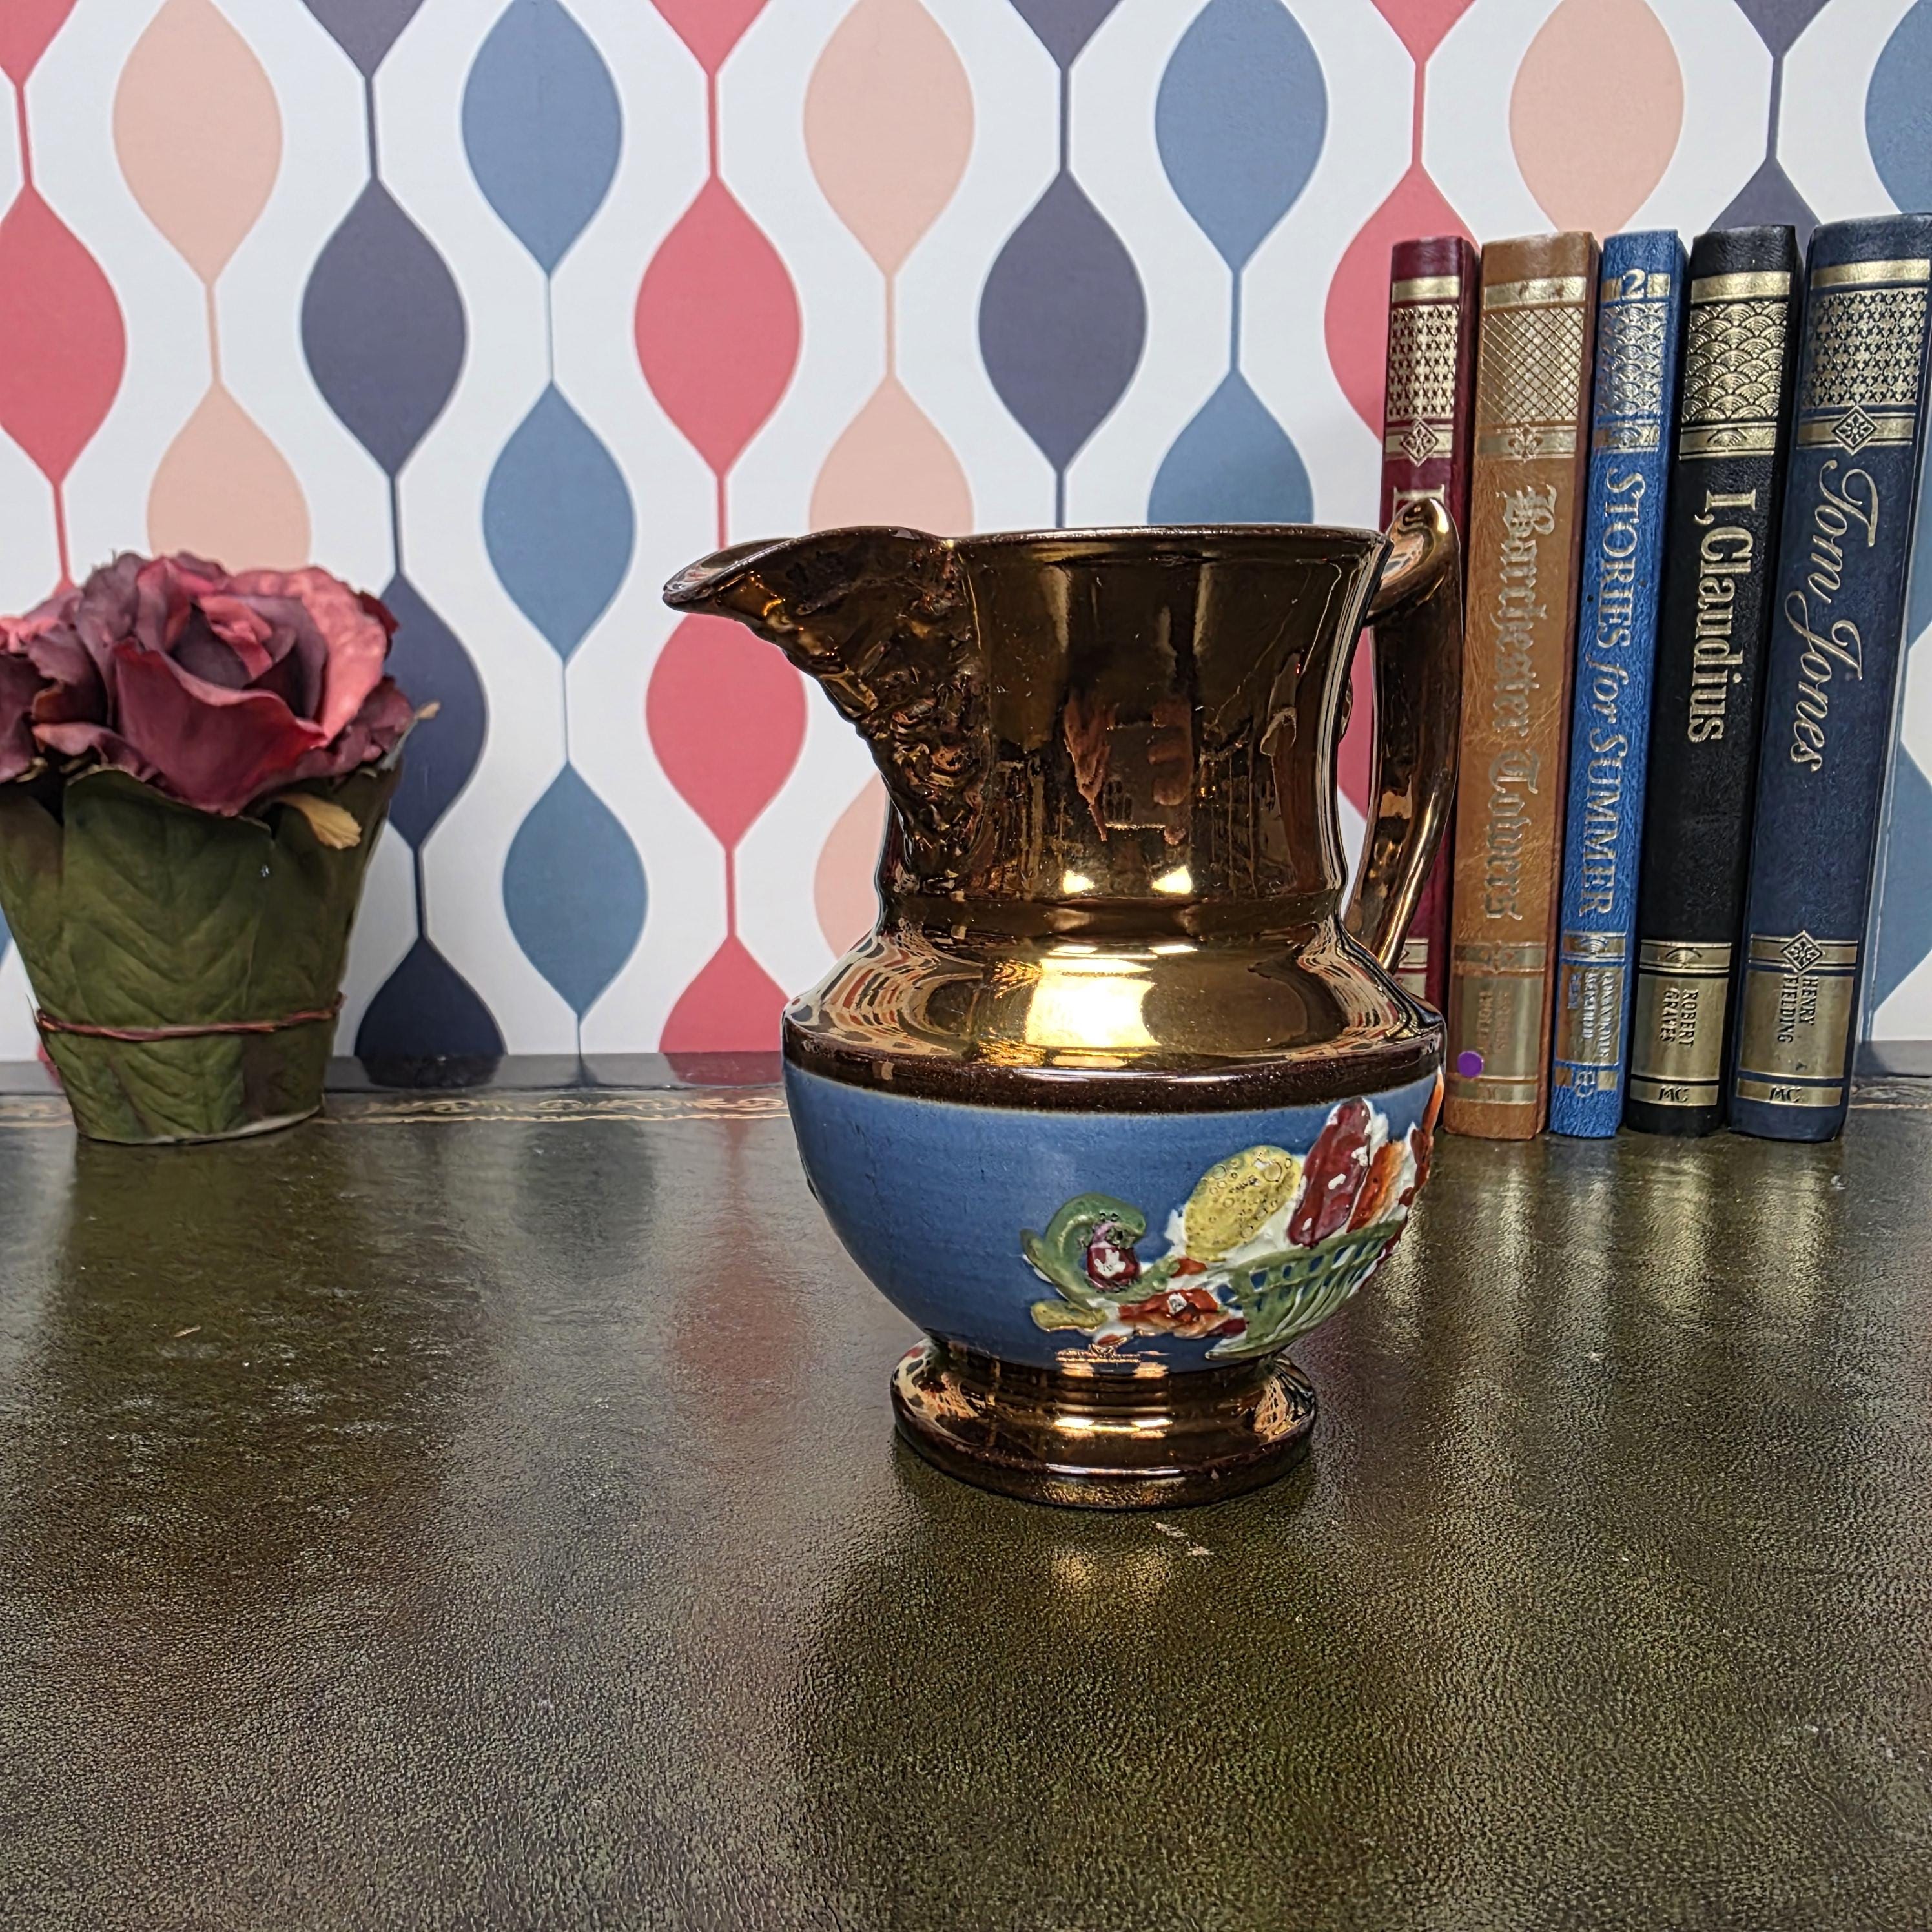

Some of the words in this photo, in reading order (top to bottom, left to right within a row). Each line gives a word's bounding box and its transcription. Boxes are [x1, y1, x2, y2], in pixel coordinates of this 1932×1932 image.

[1622, 268, 1645, 300] 2
[1596, 468, 1645, 648] STORIES
[1808, 460, 1878, 604] Tom
[1490, 484, 1557, 737] Barchester
[1585, 652, 1629, 724] for
[1785, 591, 1862, 772] Jones
[1485, 749, 1539, 920] Towers
[1579, 728, 1628, 917] SUMMER
[1660, 987, 1679, 1043] GRAVES
[1679, 989, 1698, 1047] ROBERT
[1777, 974, 1798, 1043] FIELDING
[1798, 976, 1818, 1026] HENRY
